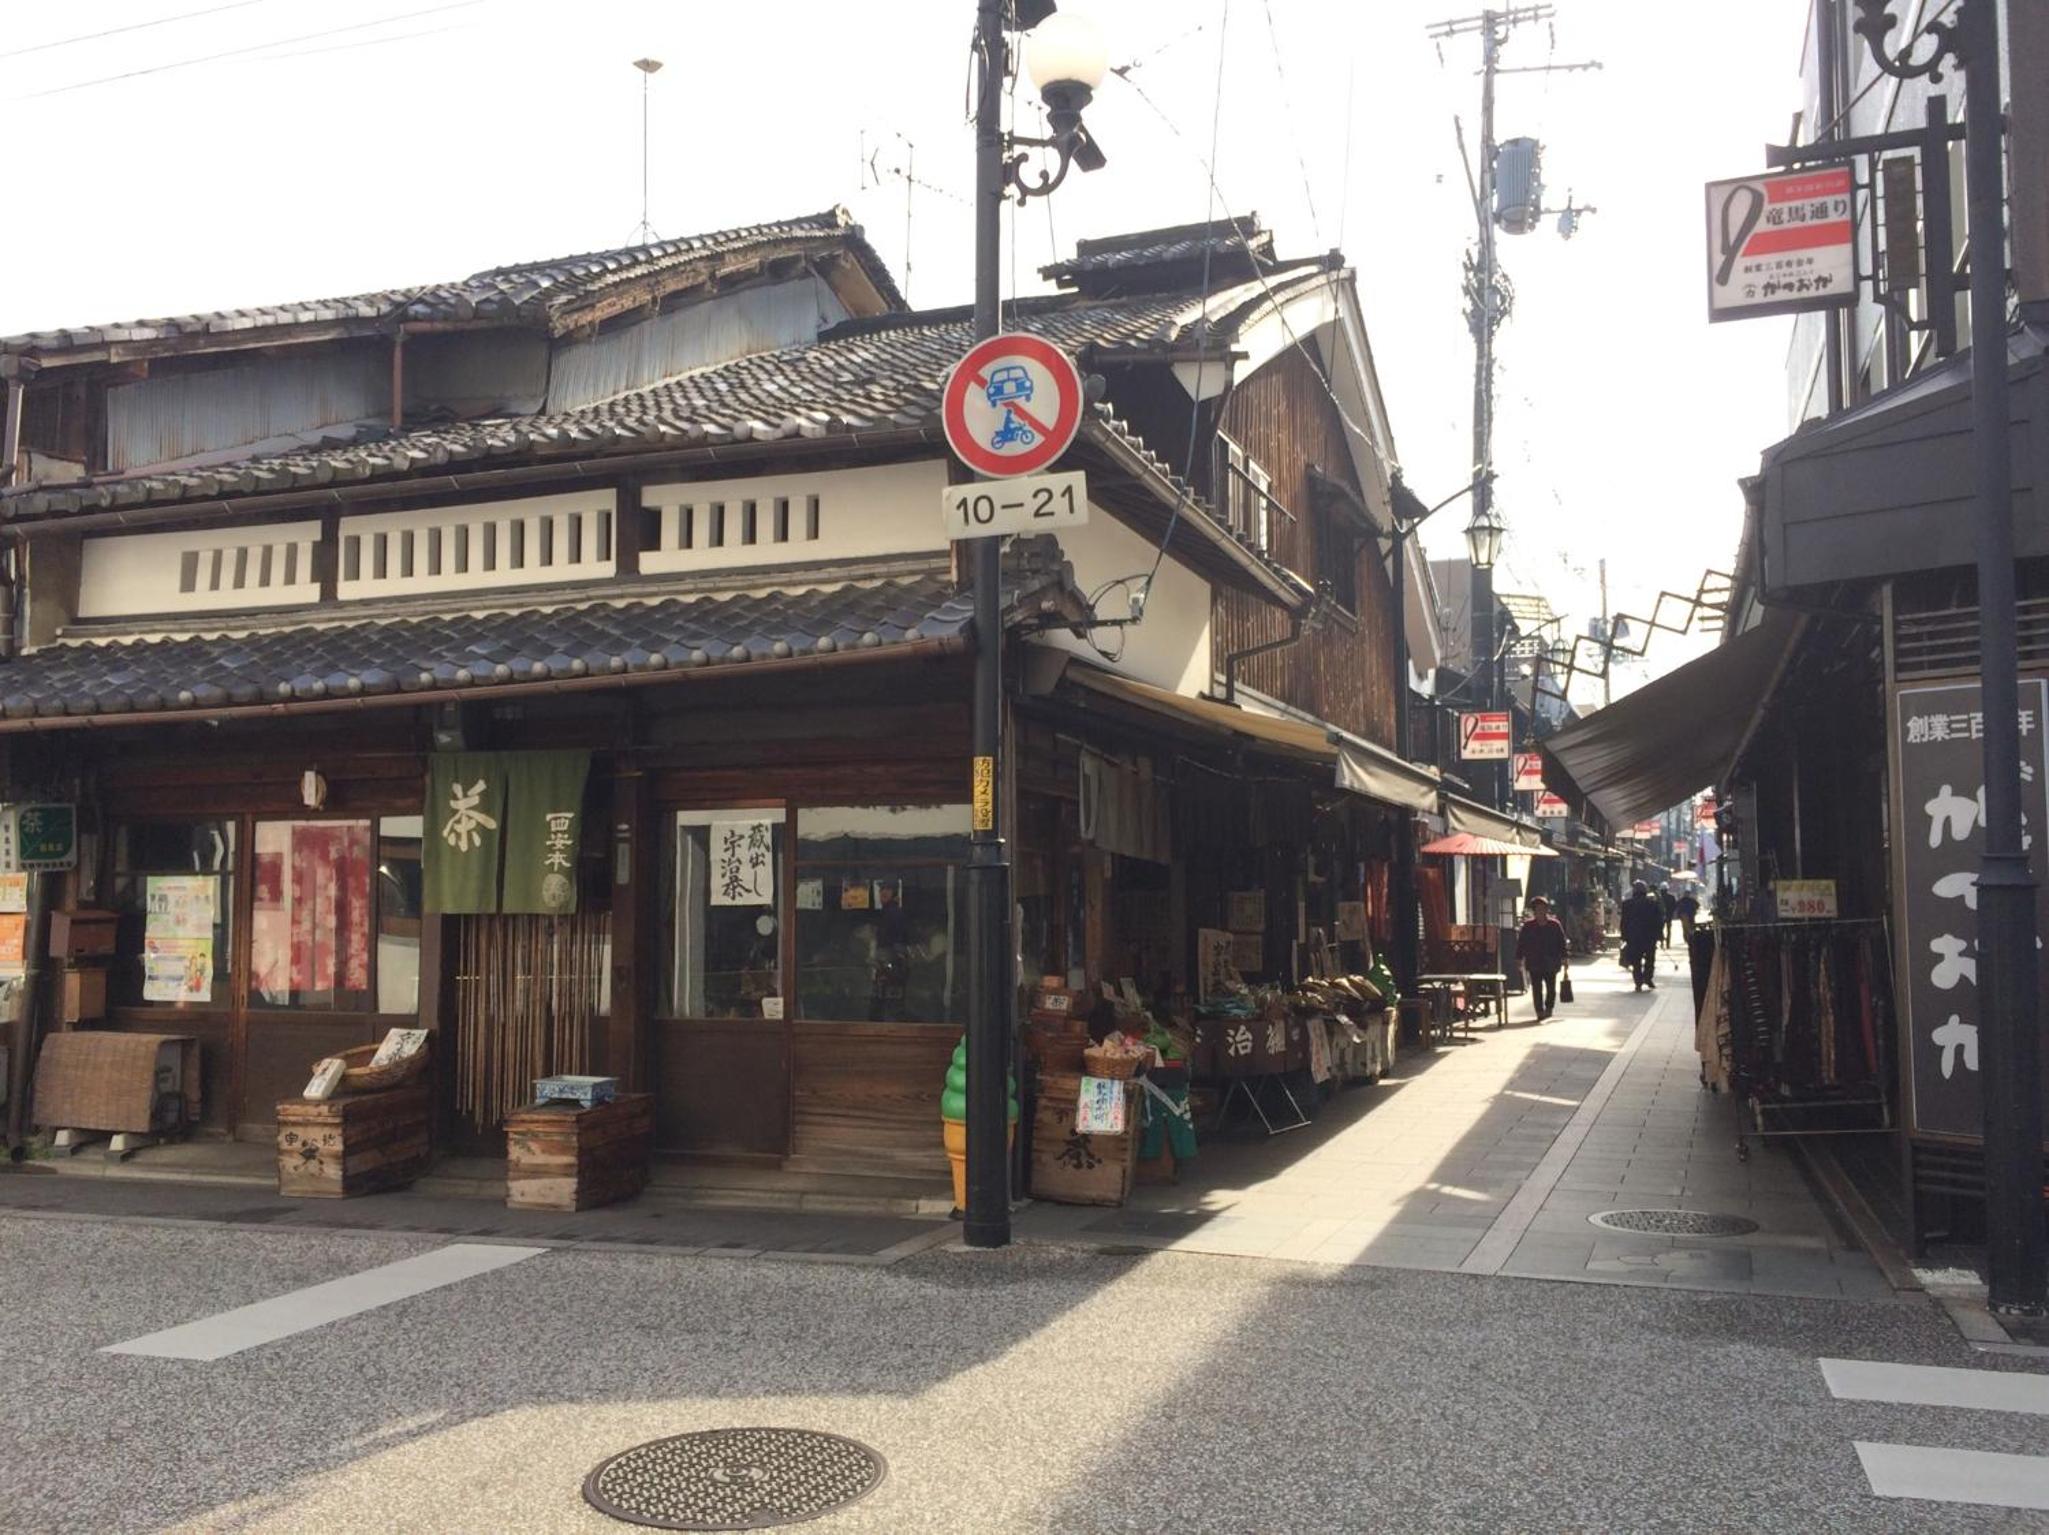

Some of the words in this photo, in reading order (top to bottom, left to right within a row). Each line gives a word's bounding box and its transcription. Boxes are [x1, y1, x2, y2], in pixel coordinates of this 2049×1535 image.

[1765, 200, 1848, 226] 竜馬通り
[1907, 710, 2036, 743] 創業三百年
[442, 779, 497, 853] 茶
[720, 829, 753, 901] 宇治茶
[747, 823, 771, 897] 蔵出し
